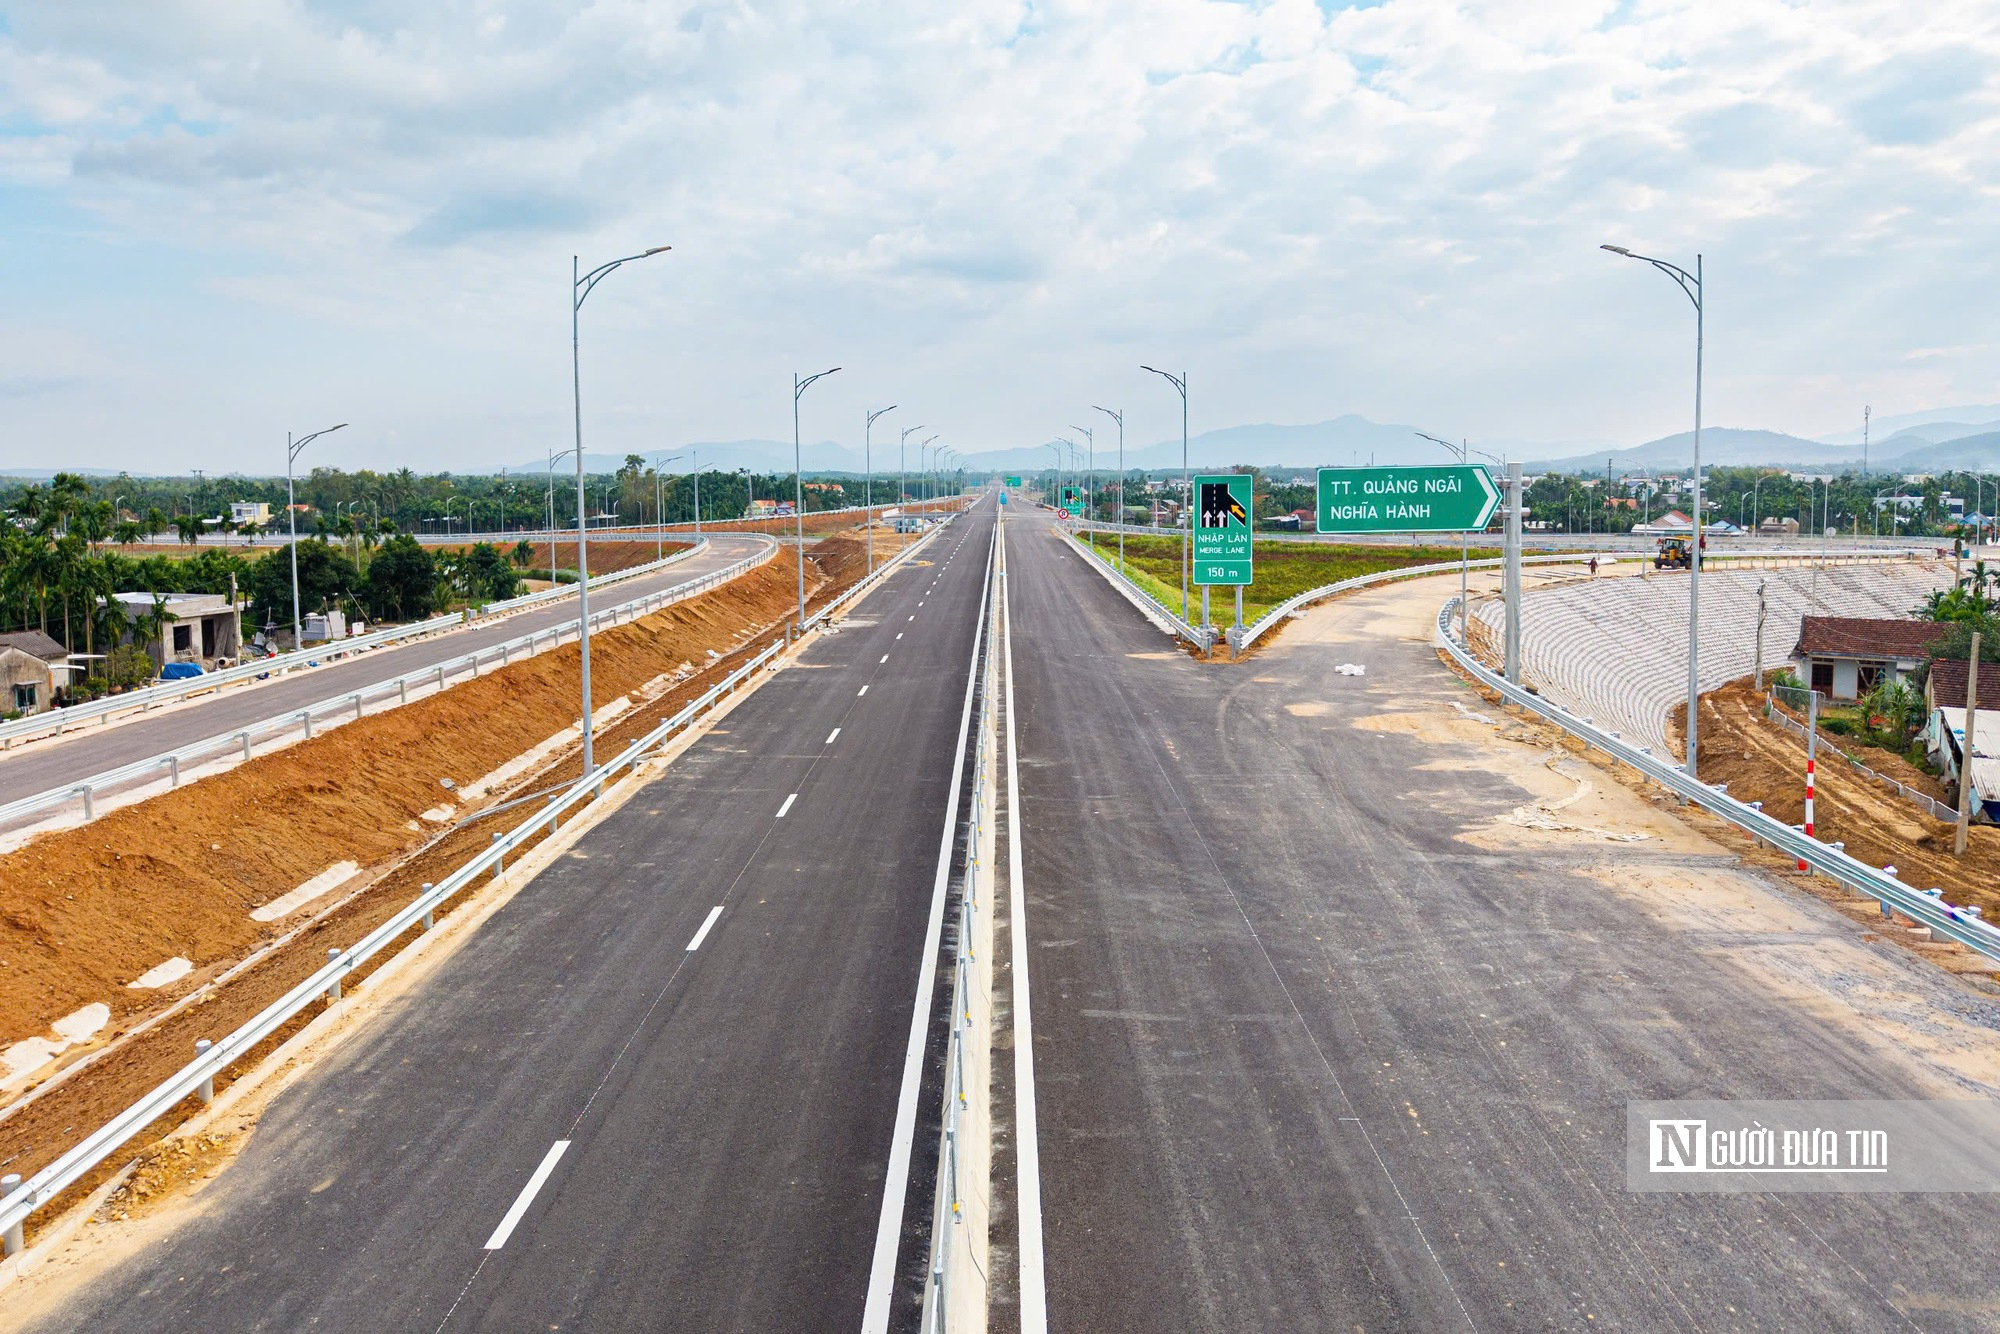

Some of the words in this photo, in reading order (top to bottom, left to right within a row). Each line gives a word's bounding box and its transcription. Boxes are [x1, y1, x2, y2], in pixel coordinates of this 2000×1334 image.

[1331, 481, 1357, 495] TT.
[1363, 474, 1418, 494] QUẢNG
[1424, 475, 1462, 493] NGÃI
[1330, 501, 1378, 519] NGHĨA
[1386, 500, 1430, 518] HÀNH
[1198, 532, 1224, 544] NHẬP
[1227, 532, 1248, 543] LÀN
[1207, 567, 1224, 577] 150
